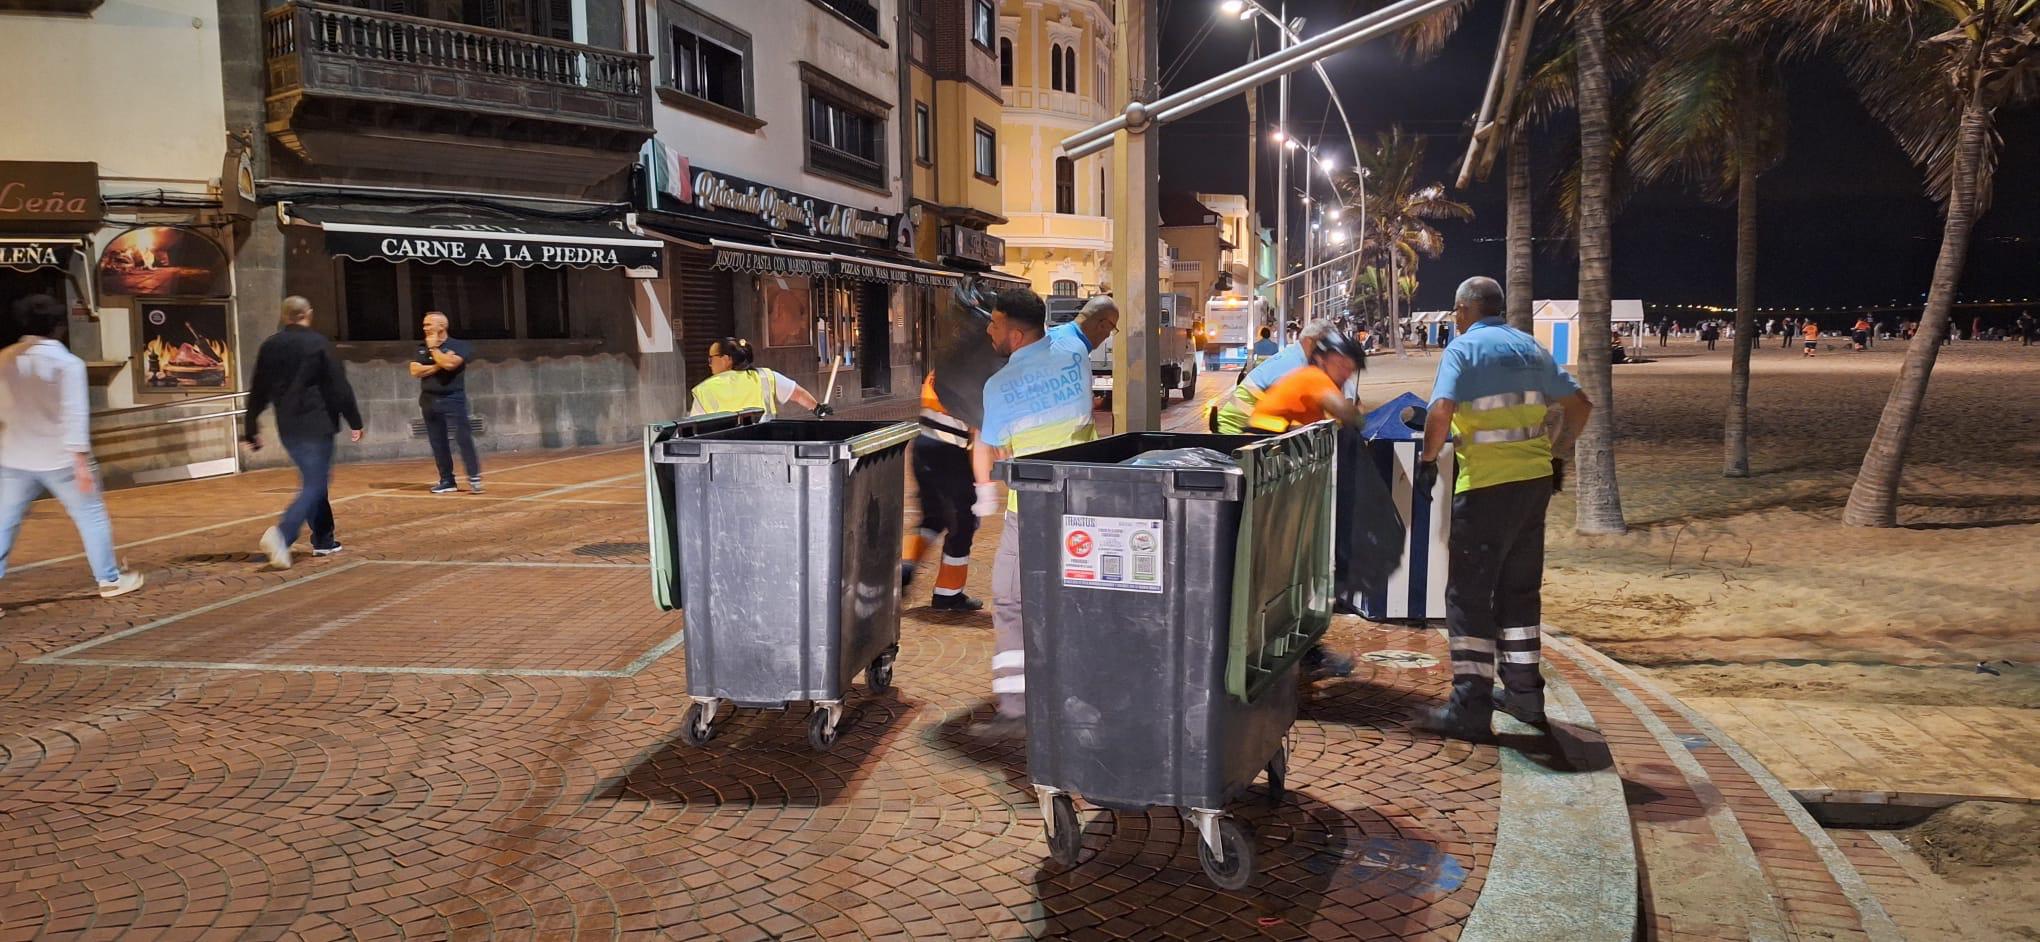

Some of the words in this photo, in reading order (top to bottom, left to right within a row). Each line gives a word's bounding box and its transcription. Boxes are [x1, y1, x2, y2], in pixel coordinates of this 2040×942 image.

[0, 181, 88, 213] Leña
[695, 172, 760, 215] Ristorante
[0, 243, 59, 264] LEÑA
[381, 238, 466, 259] CARNE
[475, 245, 494, 261] A
[504, 244, 533, 262] LA
[542, 246, 620, 264] PIEDRA
[716, 250, 745, 267] RISOTTO
[753, 254, 772, 270] PASTA
[773, 256, 786, 271] CON
[840, 262, 861, 275] PIZZAS
[861, 265, 875, 277] CON
[875, 267, 889, 280] MASA
[1053, 383, 1083, 405] MAR
